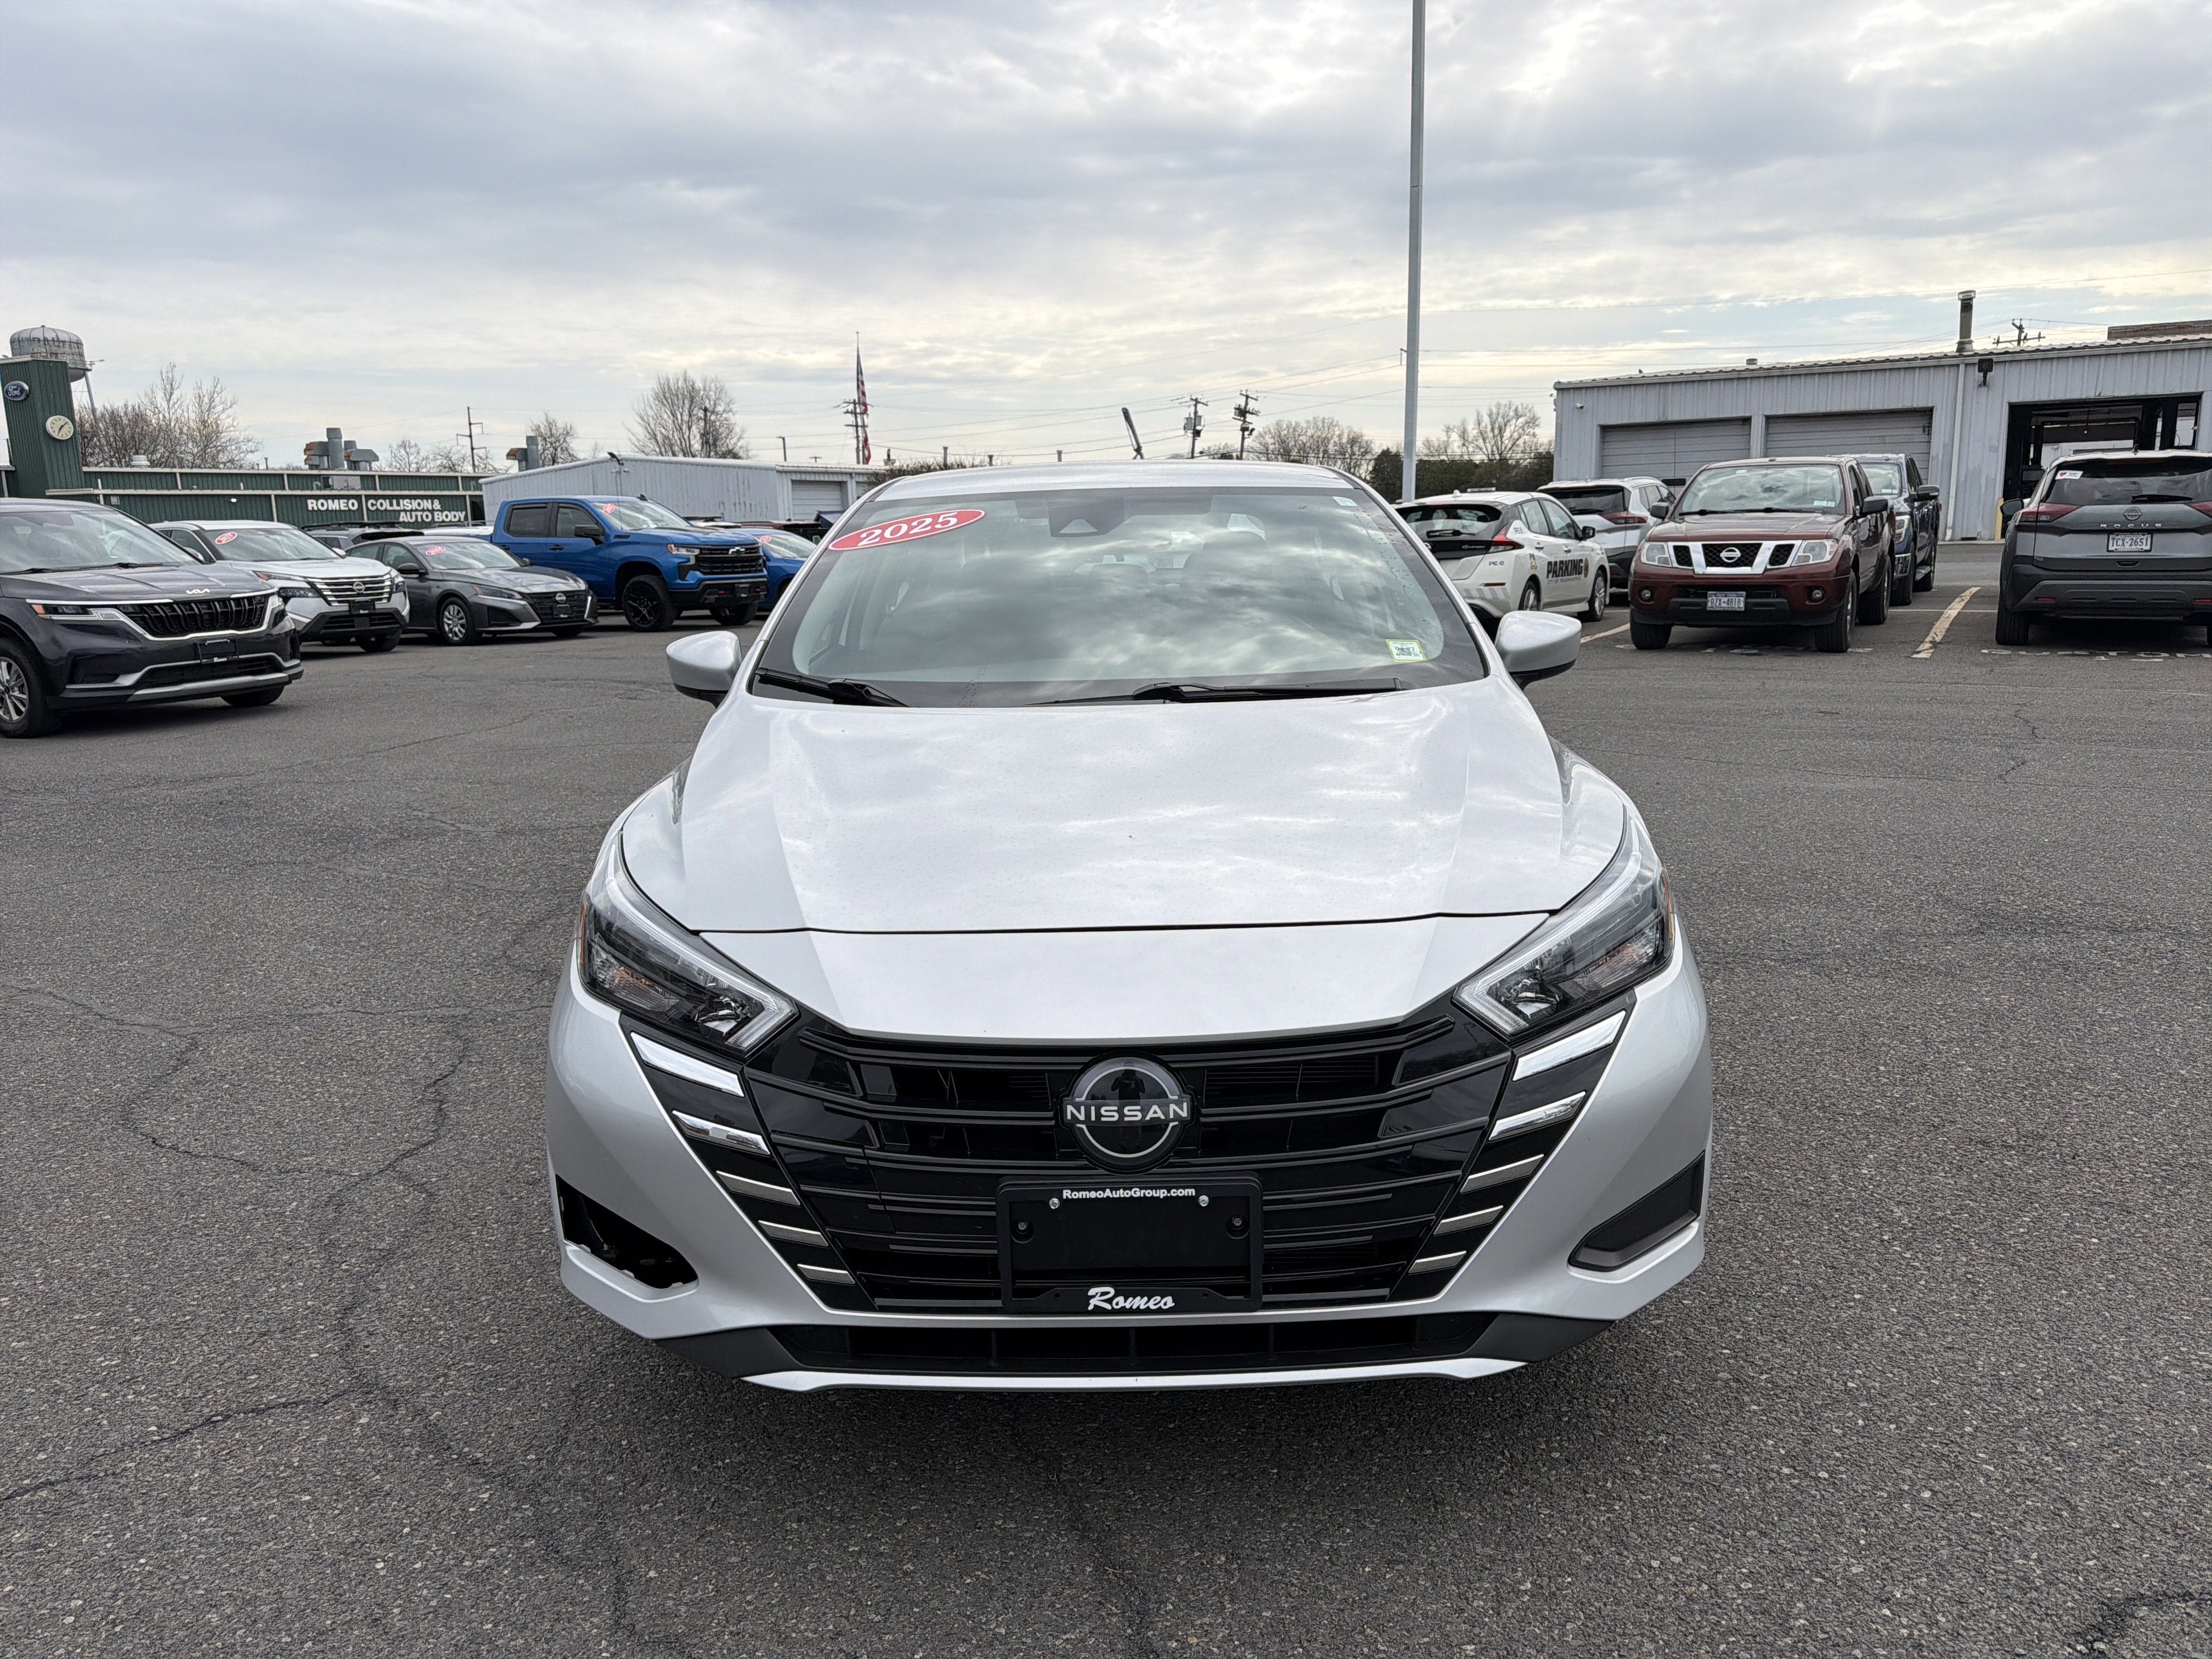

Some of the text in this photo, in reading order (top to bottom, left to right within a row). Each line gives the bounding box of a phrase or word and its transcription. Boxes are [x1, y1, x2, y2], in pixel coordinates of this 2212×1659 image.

[8, 385, 21, 397] Ford
[307, 499, 441, 511] ROMEO COLLISION &
[399, 511, 466, 522] AUTO BODY
[858, 511, 959, 548] 2025
[2111, 538, 2148, 547] TCX-2651
[1546, 558, 1583, 579] PARKING
[1066, 1102, 1188, 1122] NISSAN
[1063, 1187, 1196, 1199] RomeoAutoGroup.com
[1087, 1286, 1175, 1311] Romeo
